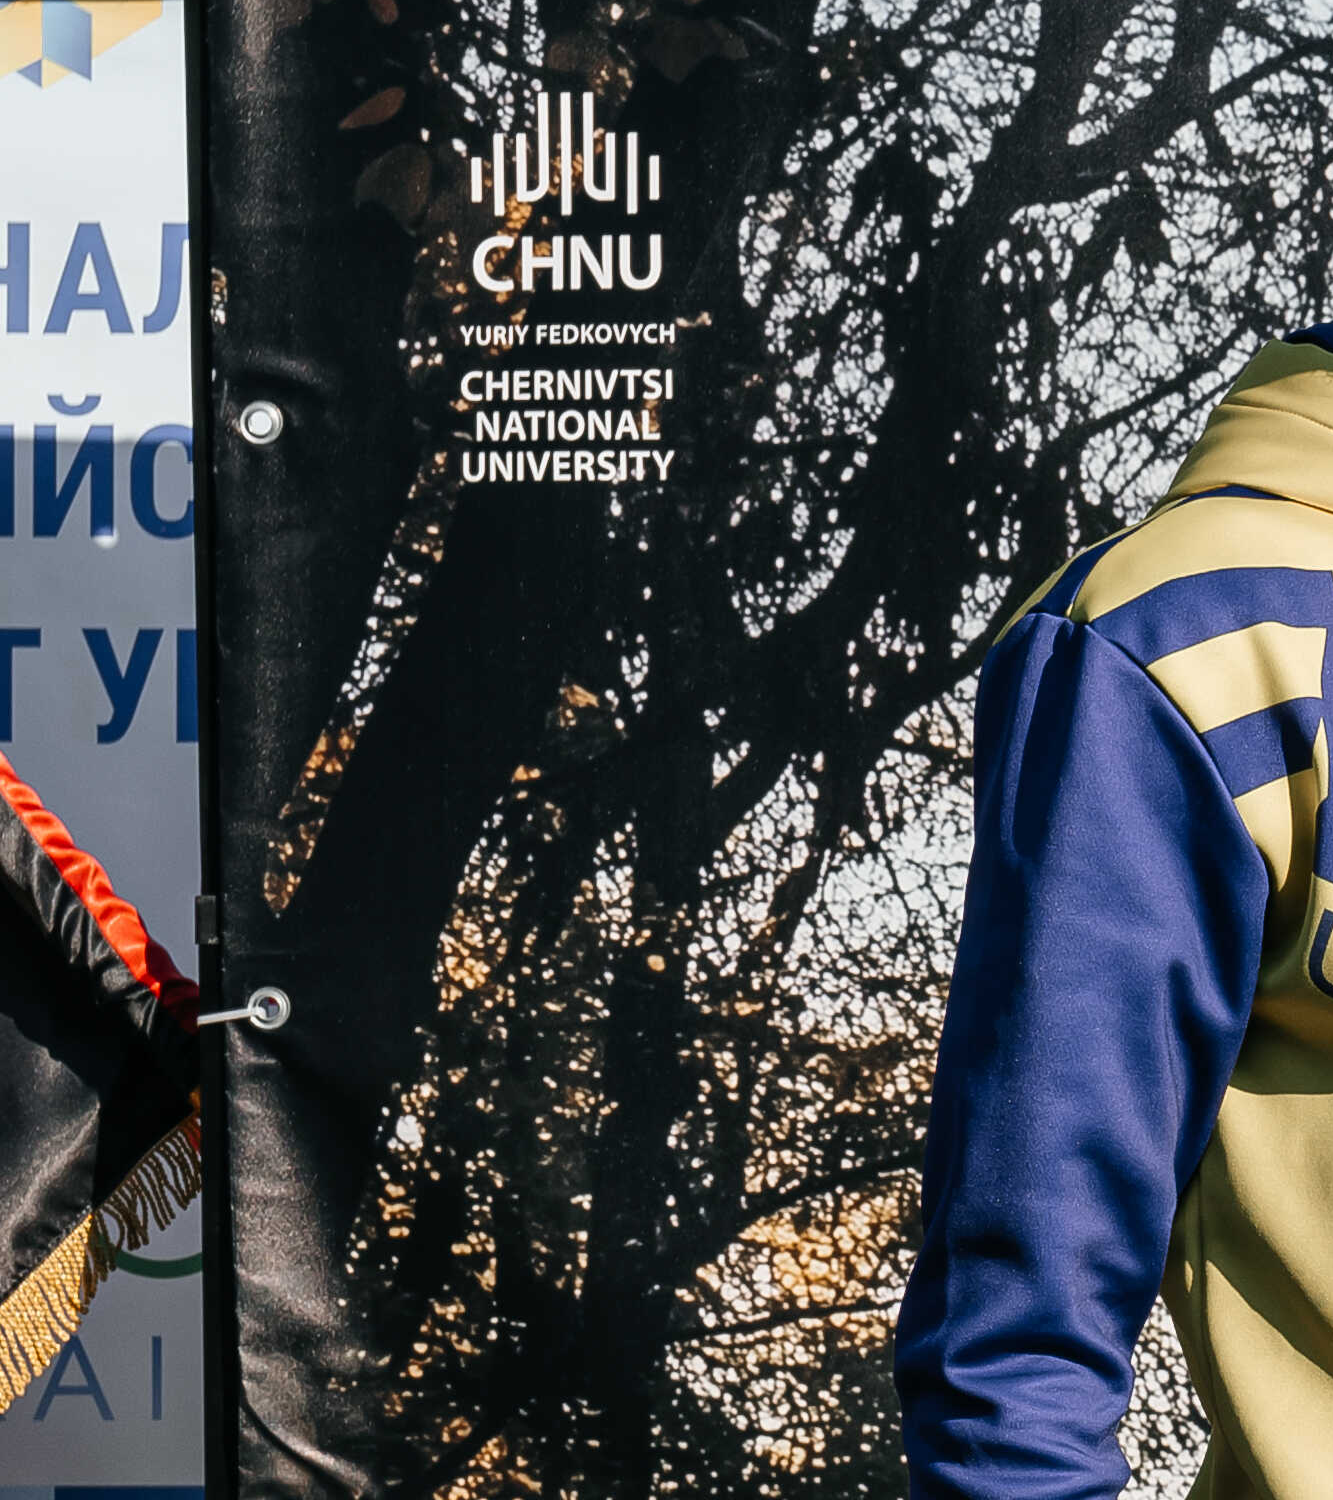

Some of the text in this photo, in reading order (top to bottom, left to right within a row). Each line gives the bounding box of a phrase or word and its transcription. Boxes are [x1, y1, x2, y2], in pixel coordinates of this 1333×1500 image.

[473, 234, 662, 293] CHNU
[460, 323, 677, 347] YURIY FEDKOVYCH
[460, 368, 674, 402] CHERNIVTSI
[475, 409, 662, 442] NATIONAL
[462, 449, 675, 483] UNIVERSITY
[82, 628, 198, 745] У
